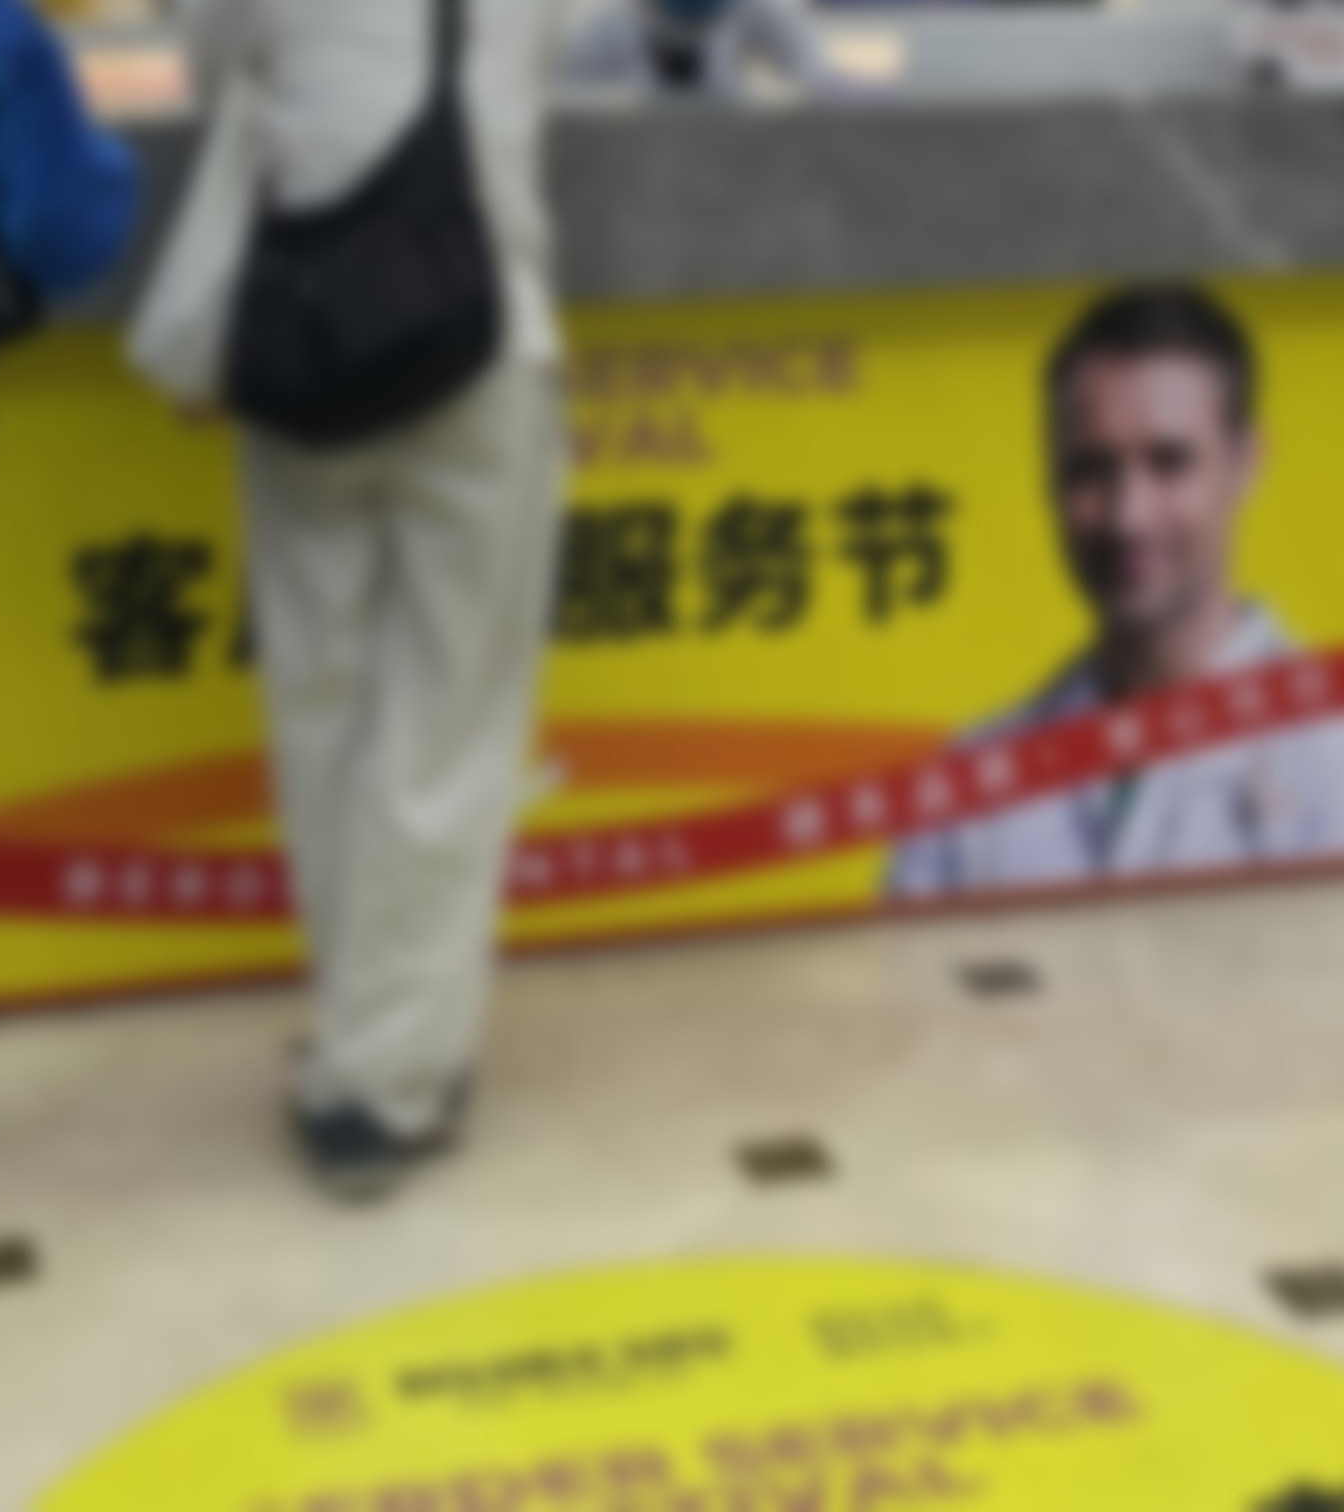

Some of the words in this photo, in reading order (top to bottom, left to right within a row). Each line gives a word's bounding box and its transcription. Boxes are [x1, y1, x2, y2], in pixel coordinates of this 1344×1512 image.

[512, 831, 690, 884] NTAL
[248, 1451, 670, 1512] ERDER
[703, 1378, 1146, 1486] SERVICE
